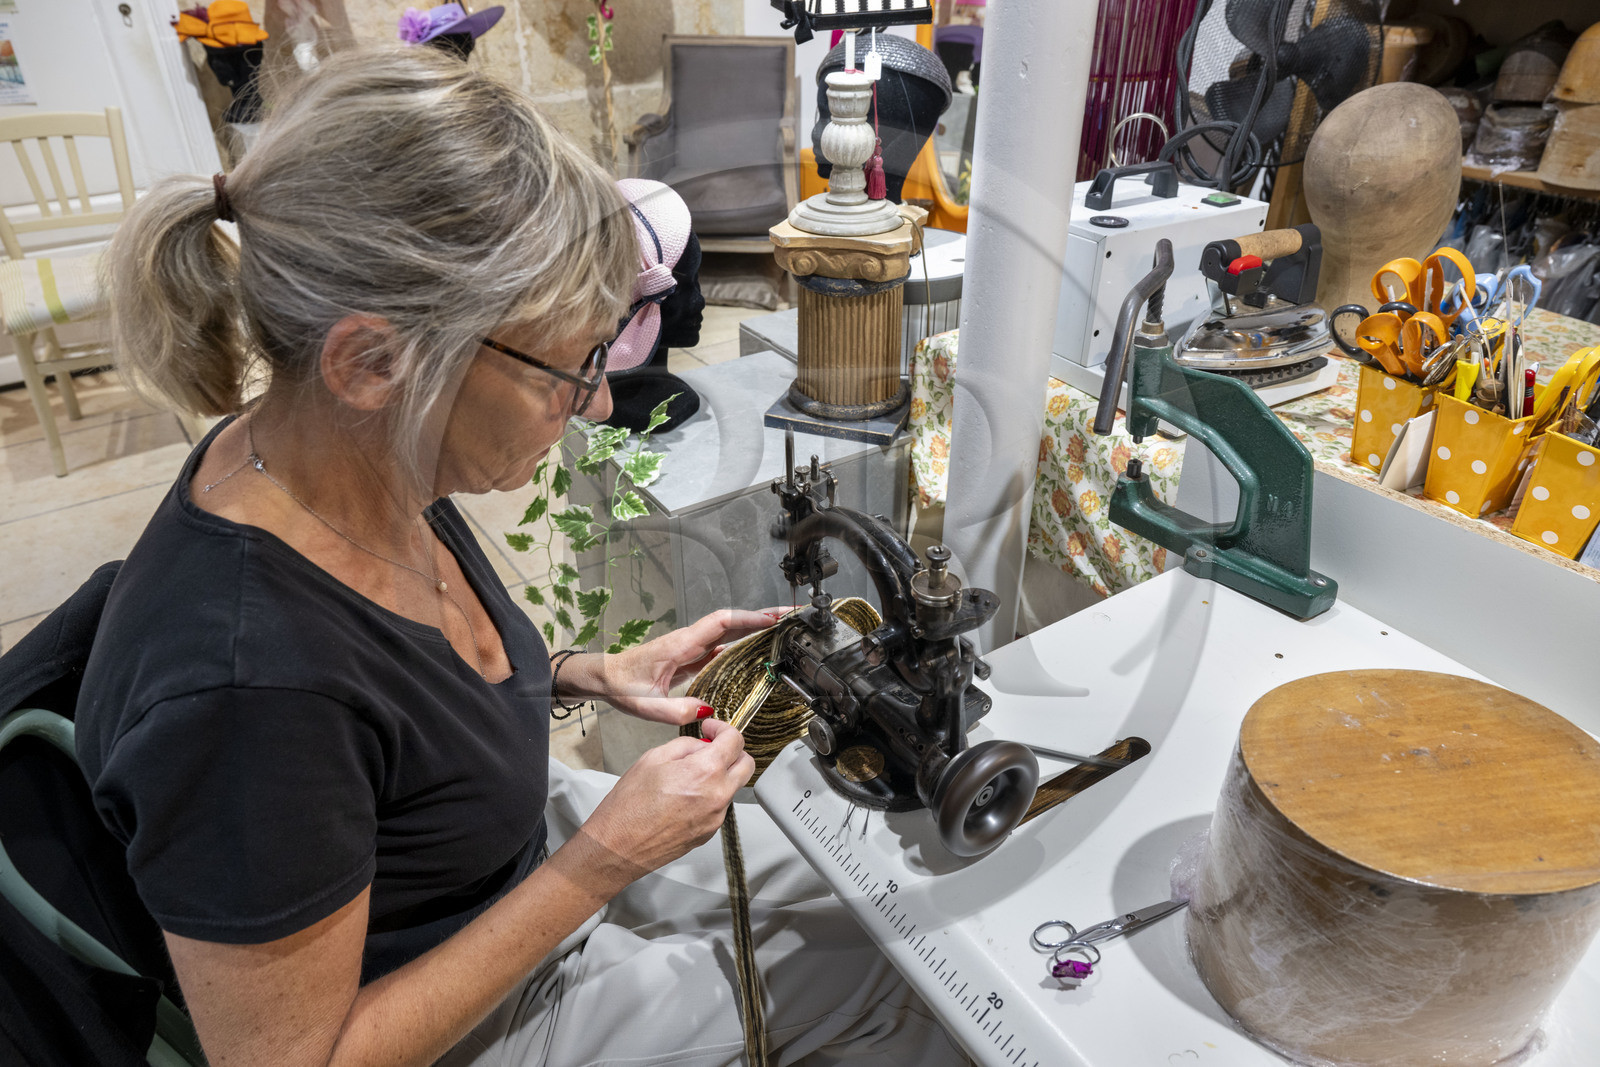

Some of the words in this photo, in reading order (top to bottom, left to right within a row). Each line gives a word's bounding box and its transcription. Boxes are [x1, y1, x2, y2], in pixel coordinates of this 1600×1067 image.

[803, 789, 812, 799] 0
[886, 879, 899, 894] 10
[987, 991, 1004, 1010] 20
